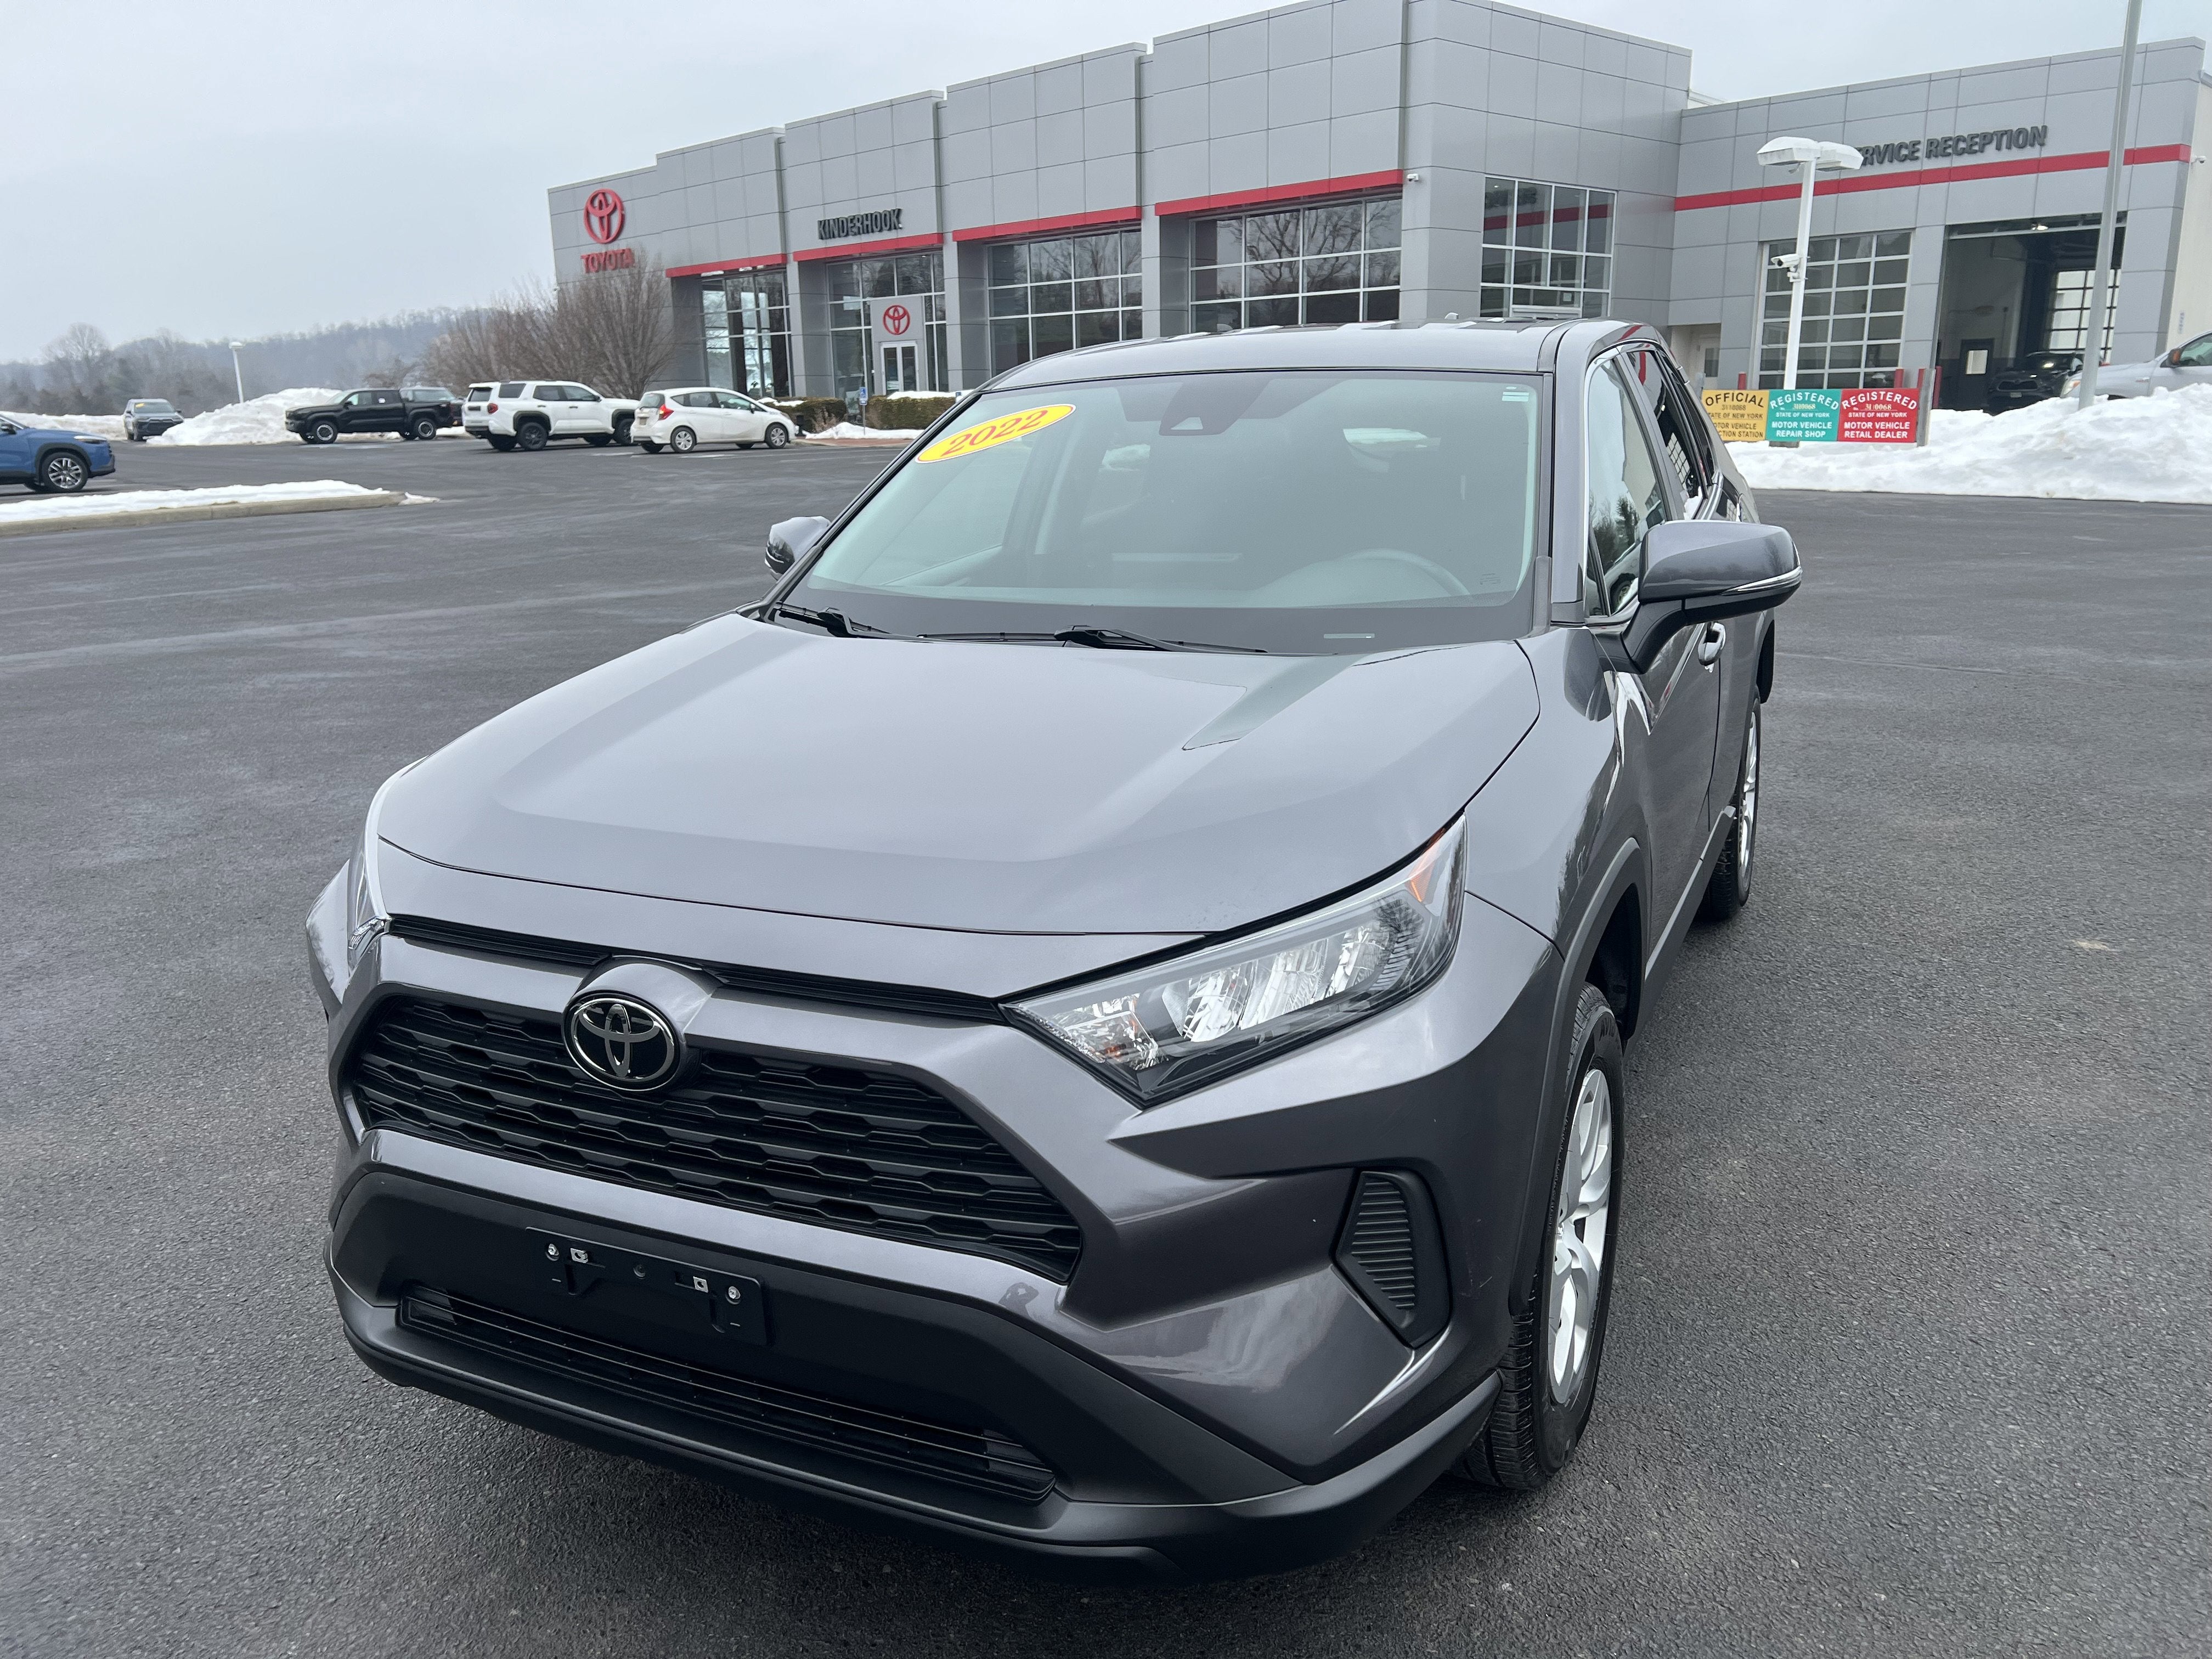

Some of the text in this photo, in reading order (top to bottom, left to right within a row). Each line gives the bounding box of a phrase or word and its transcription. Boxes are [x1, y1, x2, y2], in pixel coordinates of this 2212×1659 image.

[1854, 125, 2048, 166] RVICE RECEPTION
[817, 208, 902, 240] KINDERHOOK
[580, 248, 634, 273] TOYOTA
[1706, 392, 1764, 408] OFFICIAL
[1770, 392, 1839, 410] REGISTERED
[1842, 391, 1917, 410] REGISTERED
[940, 410, 1048, 456] 2022
